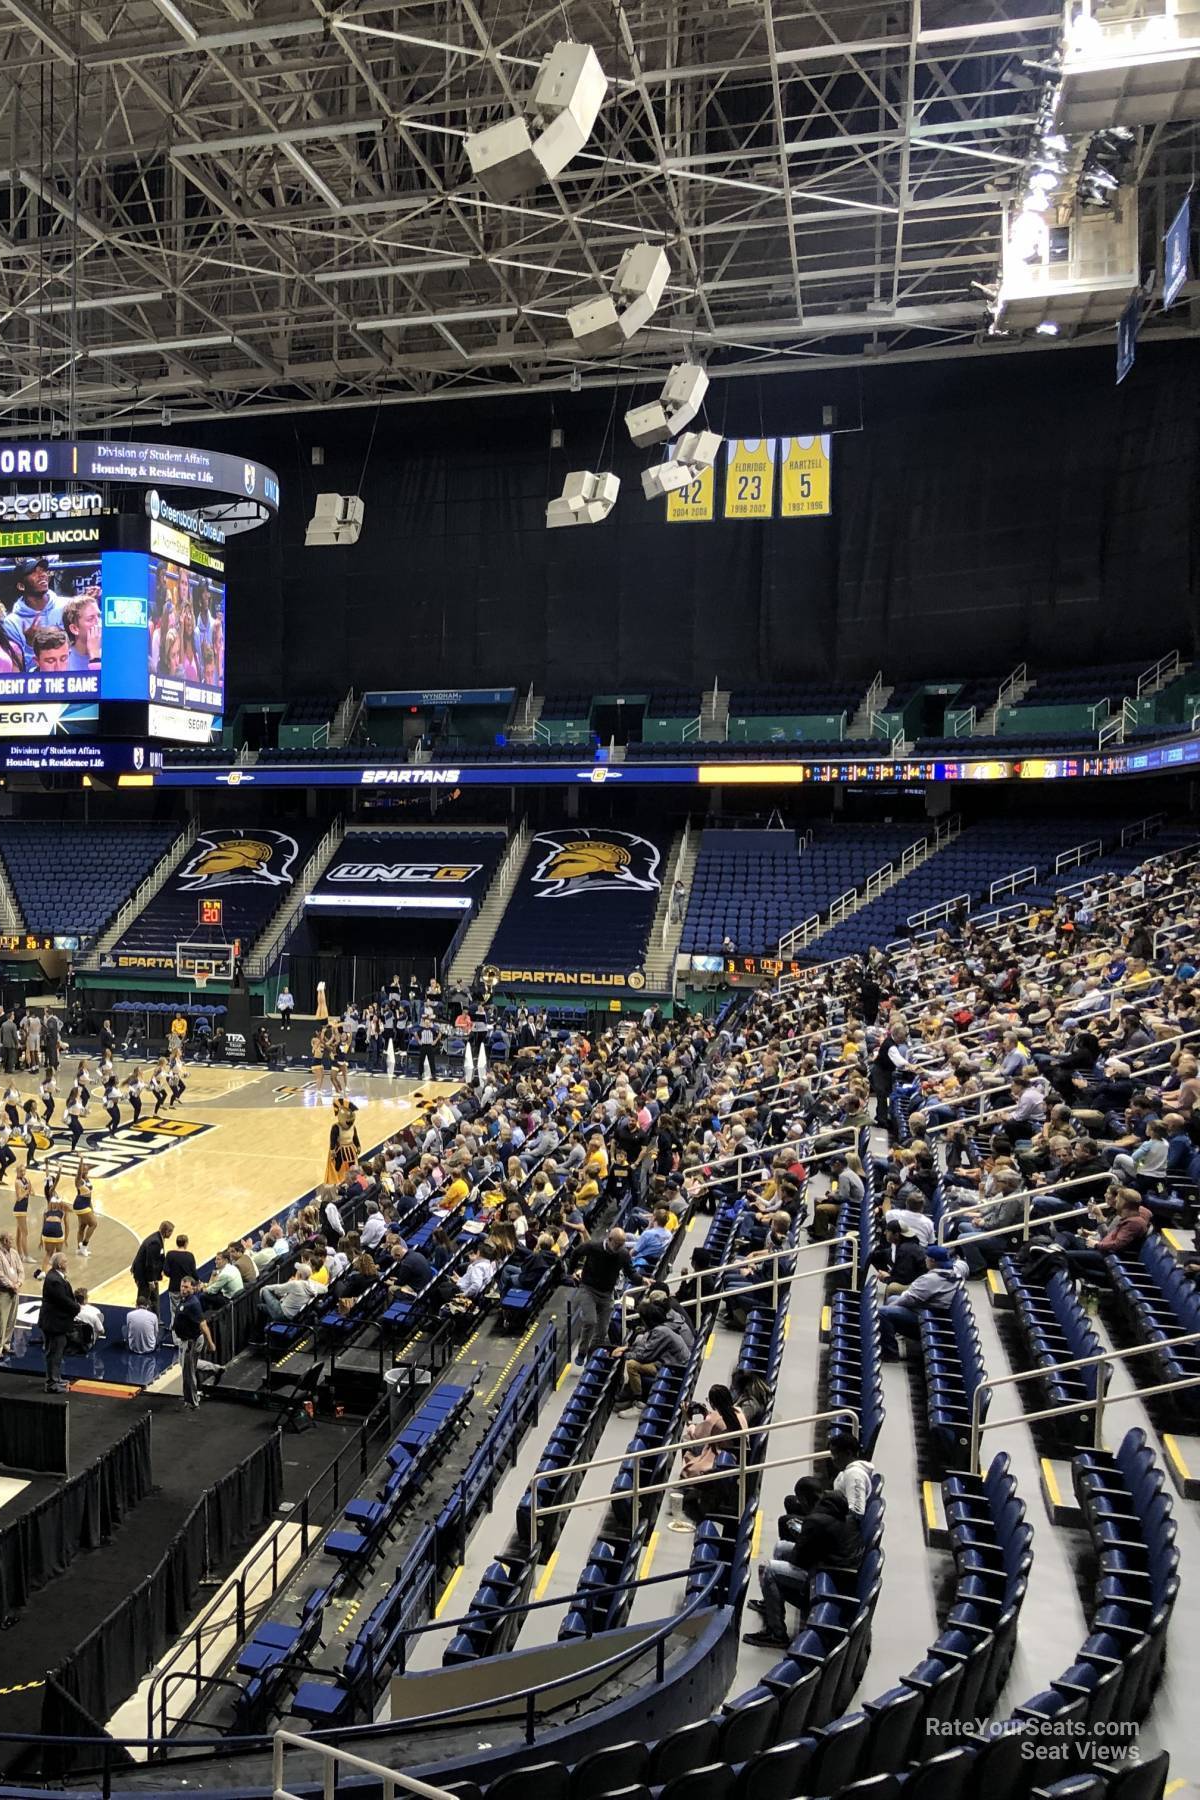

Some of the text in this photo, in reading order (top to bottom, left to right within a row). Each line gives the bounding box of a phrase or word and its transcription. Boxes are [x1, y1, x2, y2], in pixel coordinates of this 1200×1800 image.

[97, 446, 211, 466] Division of Student Affairs
[735, 462, 767, 473] ELDRIDGE
[789, 458, 822, 470] HARTZELL
[92, 463, 214, 484] Housing & Residence Life
[679, 479, 702, 504] 42
[737, 476, 762, 500] 23
[800, 473, 812, 498] 5
[14, 493, 102, 514] Coliseum
[749, 503, 766, 513] 2002
[673, 508, 689, 517] 2004
[160, 500, 226, 544] Greensboro Coliseum
[45, 529, 99, 544] LINCOLN
[28, 679, 42, 694] OF
[43, 678, 65, 693] THE
[66, 677, 98, 692] GAME
[422, 693, 458, 701] WYNDHAM
[10, 746, 39, 755] Division
[40, 746, 49, 756] of
[50, 746, 76, 755] Student
[78, 746, 101, 755] Affairs
[6, 758, 104, 768] Housing & Residence Life
[361, 769, 460, 783] SPARTANS
[805, 768, 811, 778] 1
[831, 768, 838, 778] 2
[856, 768, 867, 777] 14
[883, 768, 894, 777] 21
[909, 767, 919, 776] 44
[333, 866, 469, 880] UNCG
[203, 909, 218, 922] 20
[26, 941, 36, 949] 28
[44, 939, 50, 949] 2
[729, 963, 735, 973] 3
[500, 970, 625, 986] SPARTAN CLUB
[226, 1033, 246, 1042] TFA
